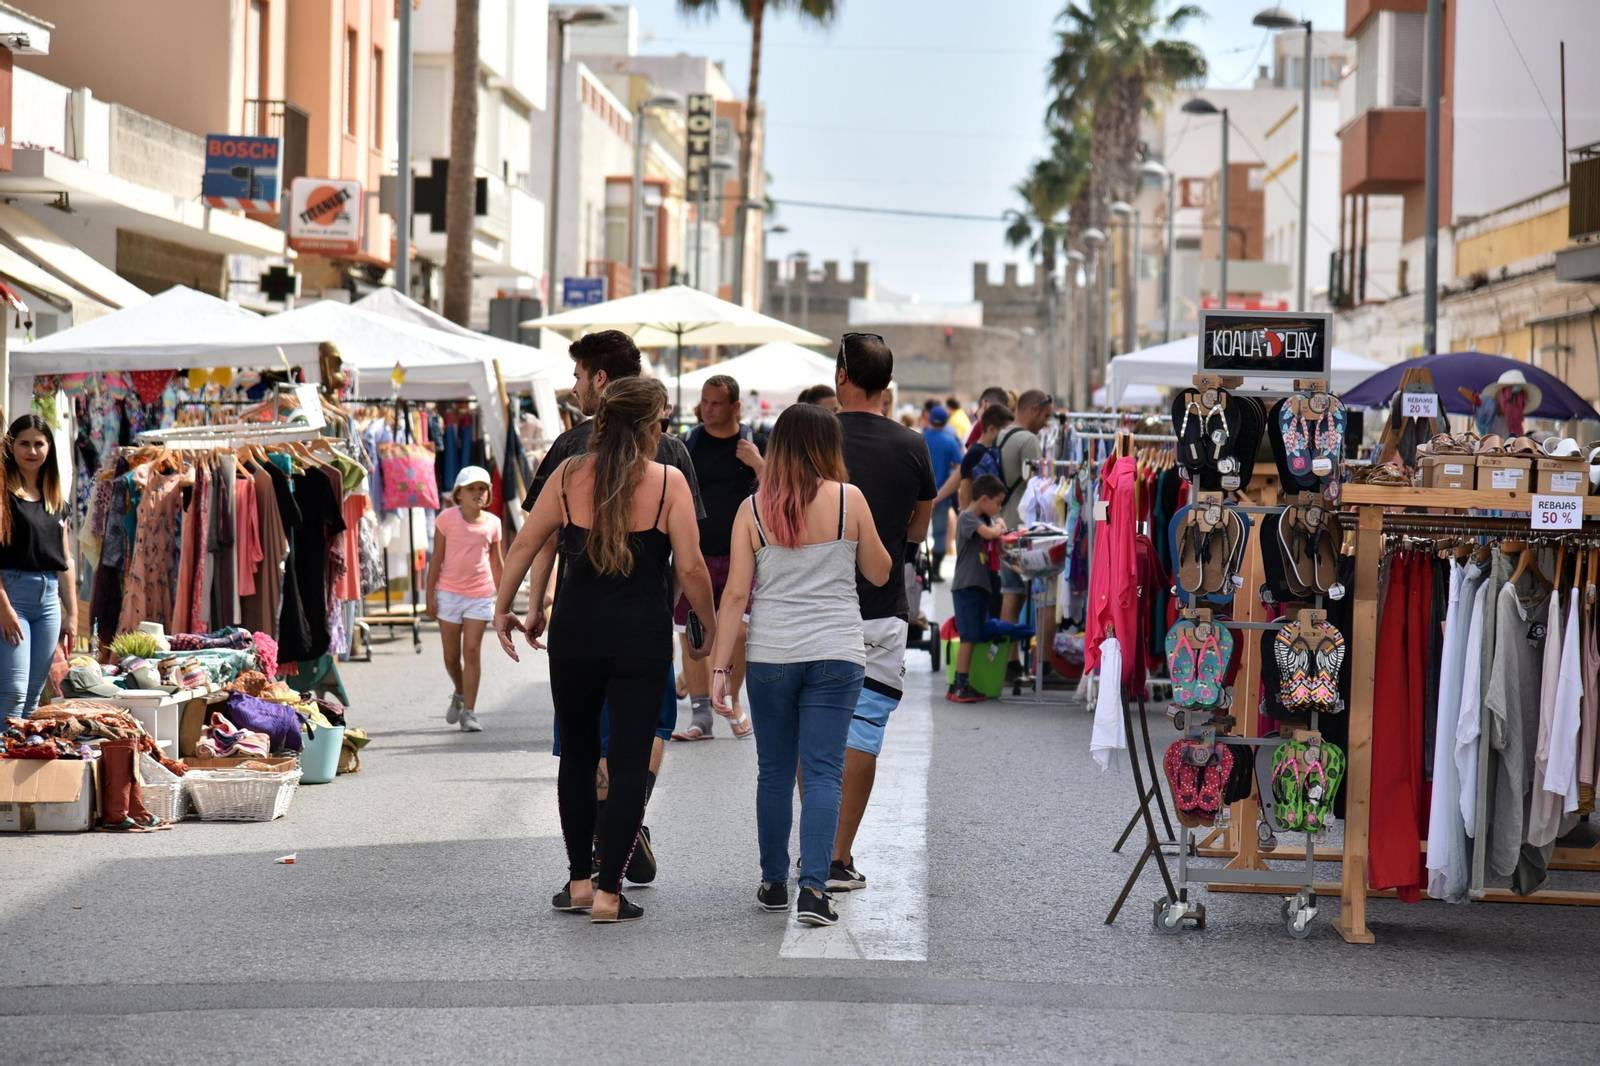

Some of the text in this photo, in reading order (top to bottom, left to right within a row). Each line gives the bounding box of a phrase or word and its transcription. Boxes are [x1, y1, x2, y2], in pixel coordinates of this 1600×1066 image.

[208, 139, 277, 160] BOSCH
[299, 186, 353, 225] TITANLUX
[1212, 329, 1317, 359] KOALA BAY
[1407, 396, 1434, 404] REBAJAS
[1409, 404, 1431, 414] 20 %
[1538, 500, 1577, 510] REBAJAS
[1541, 511, 1558, 524] 50
[1561, 511, 1573, 524] %
